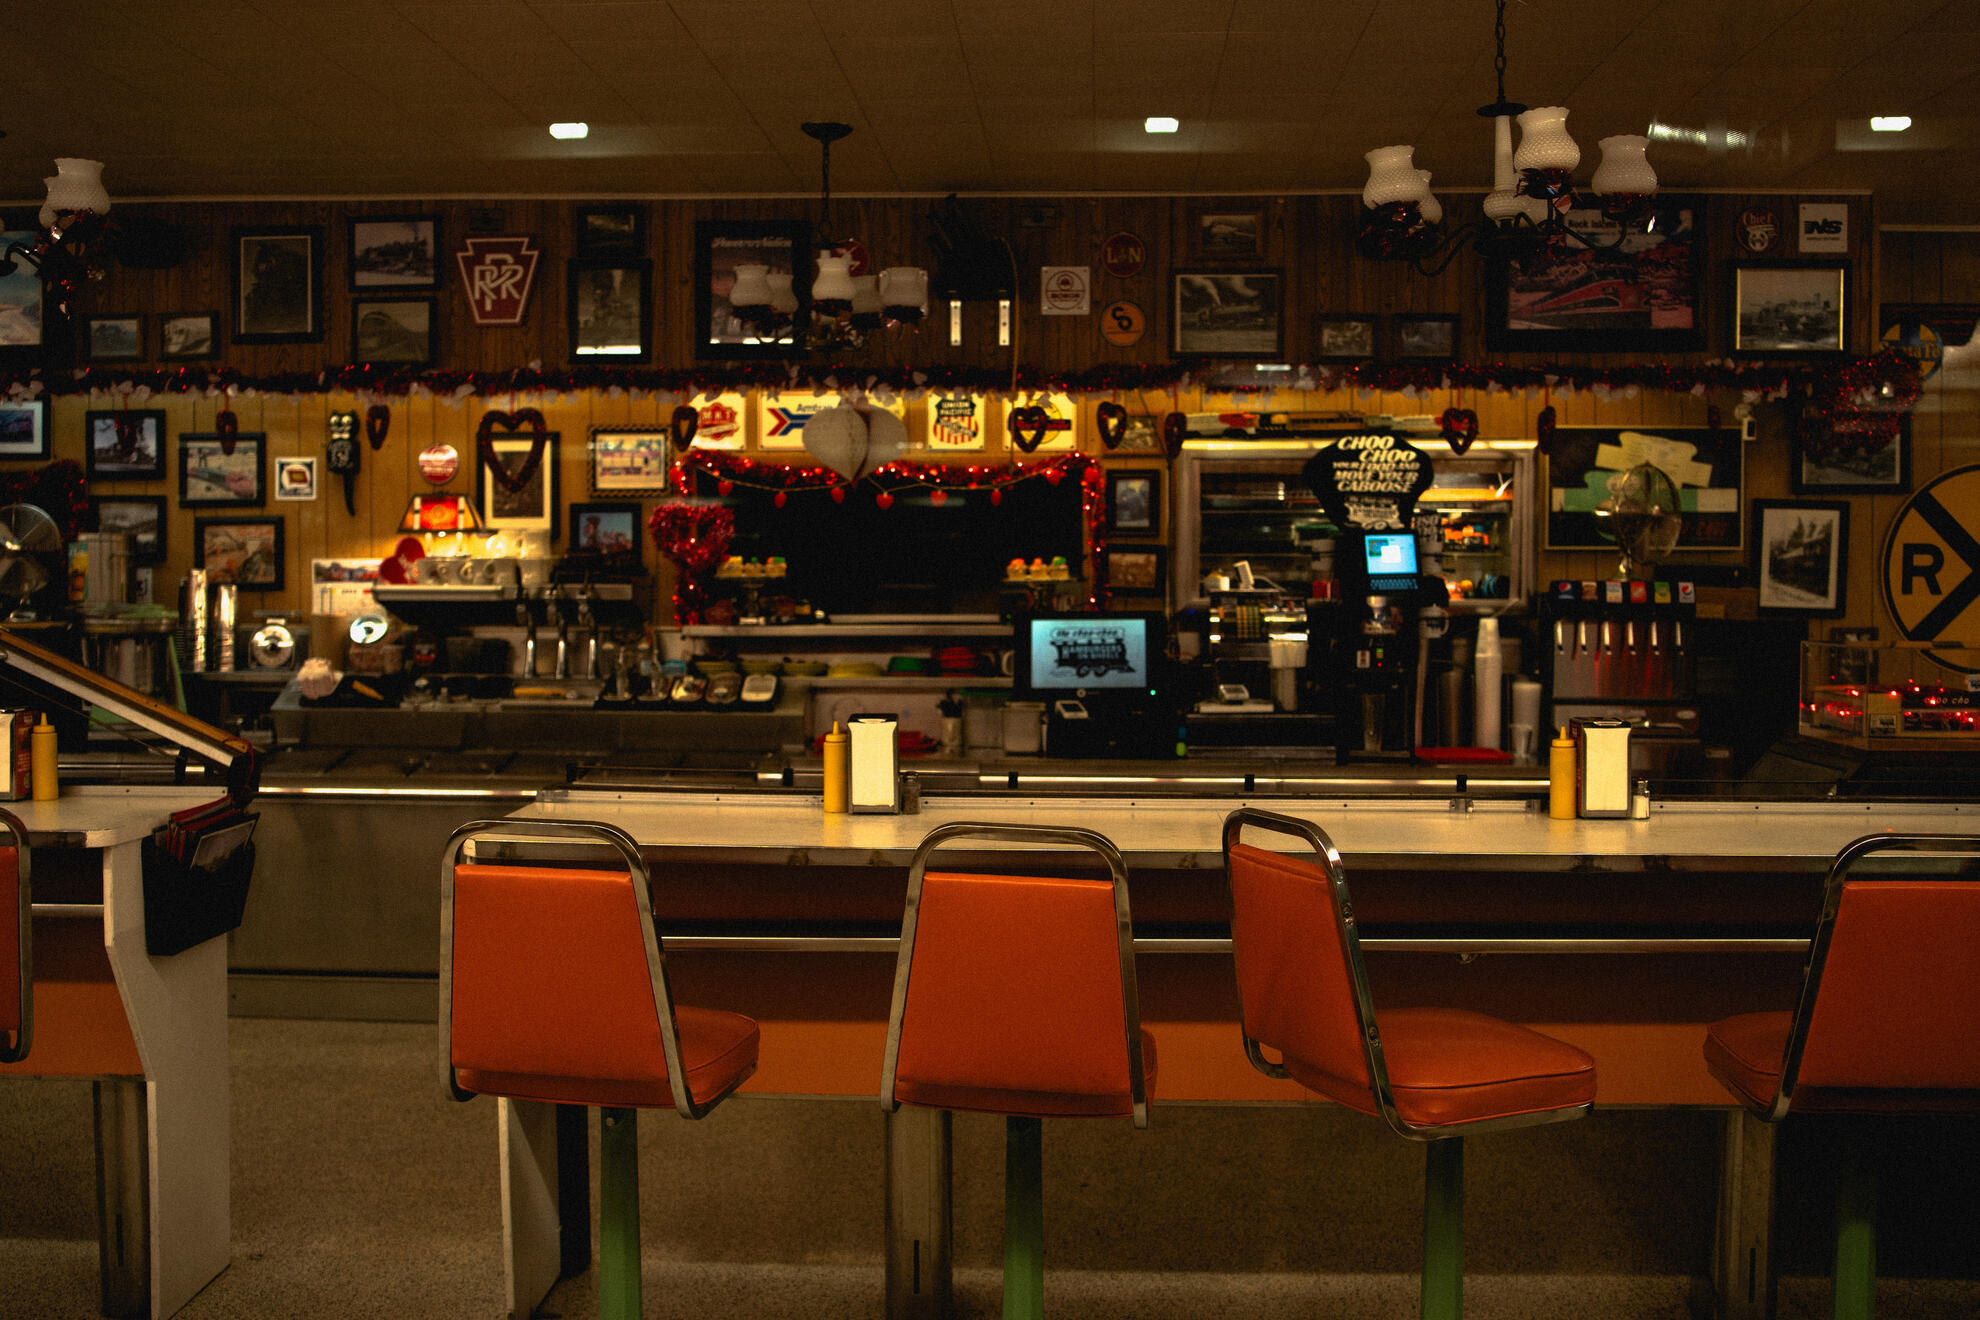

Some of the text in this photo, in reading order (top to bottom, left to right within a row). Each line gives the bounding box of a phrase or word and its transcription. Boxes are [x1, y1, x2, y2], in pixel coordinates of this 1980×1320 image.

[1337, 435, 1396, 451] CHOO
[1359, 449, 1417, 462] CHOO
[1361, 461, 1396, 471] FOOD
[1334, 470, 1419, 484] MOVE YOUR
[1337, 481, 1412, 493] CABOOSE
[1902, 543, 1945, 595] R
